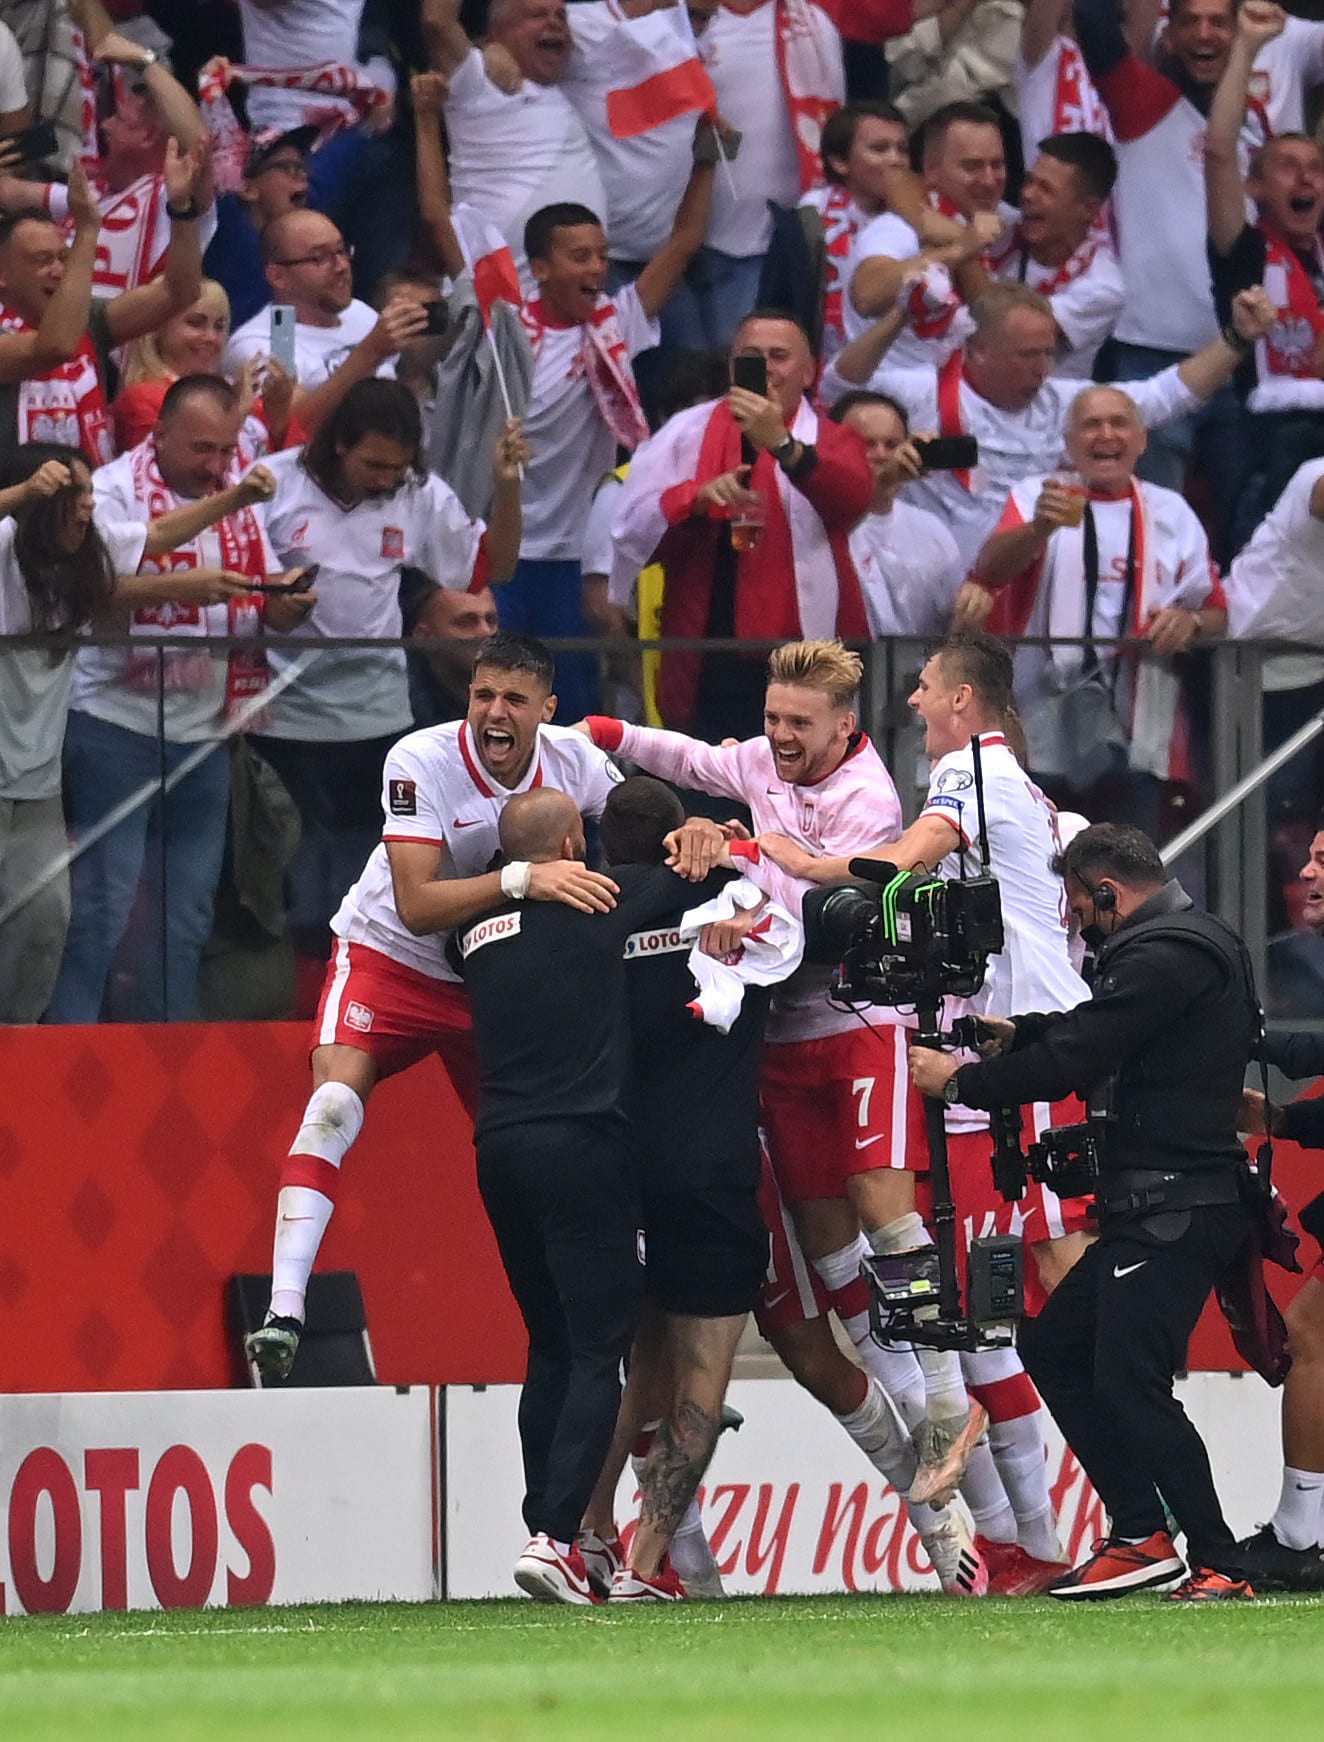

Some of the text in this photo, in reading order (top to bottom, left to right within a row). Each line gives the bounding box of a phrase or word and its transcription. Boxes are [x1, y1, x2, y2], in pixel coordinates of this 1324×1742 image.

[474, 917, 514, 943] LOTOS
[640, 932, 690, 950] LOTO
[852, 1077, 876, 1127] 7
[0, 1443, 275, 1615] OTOS
